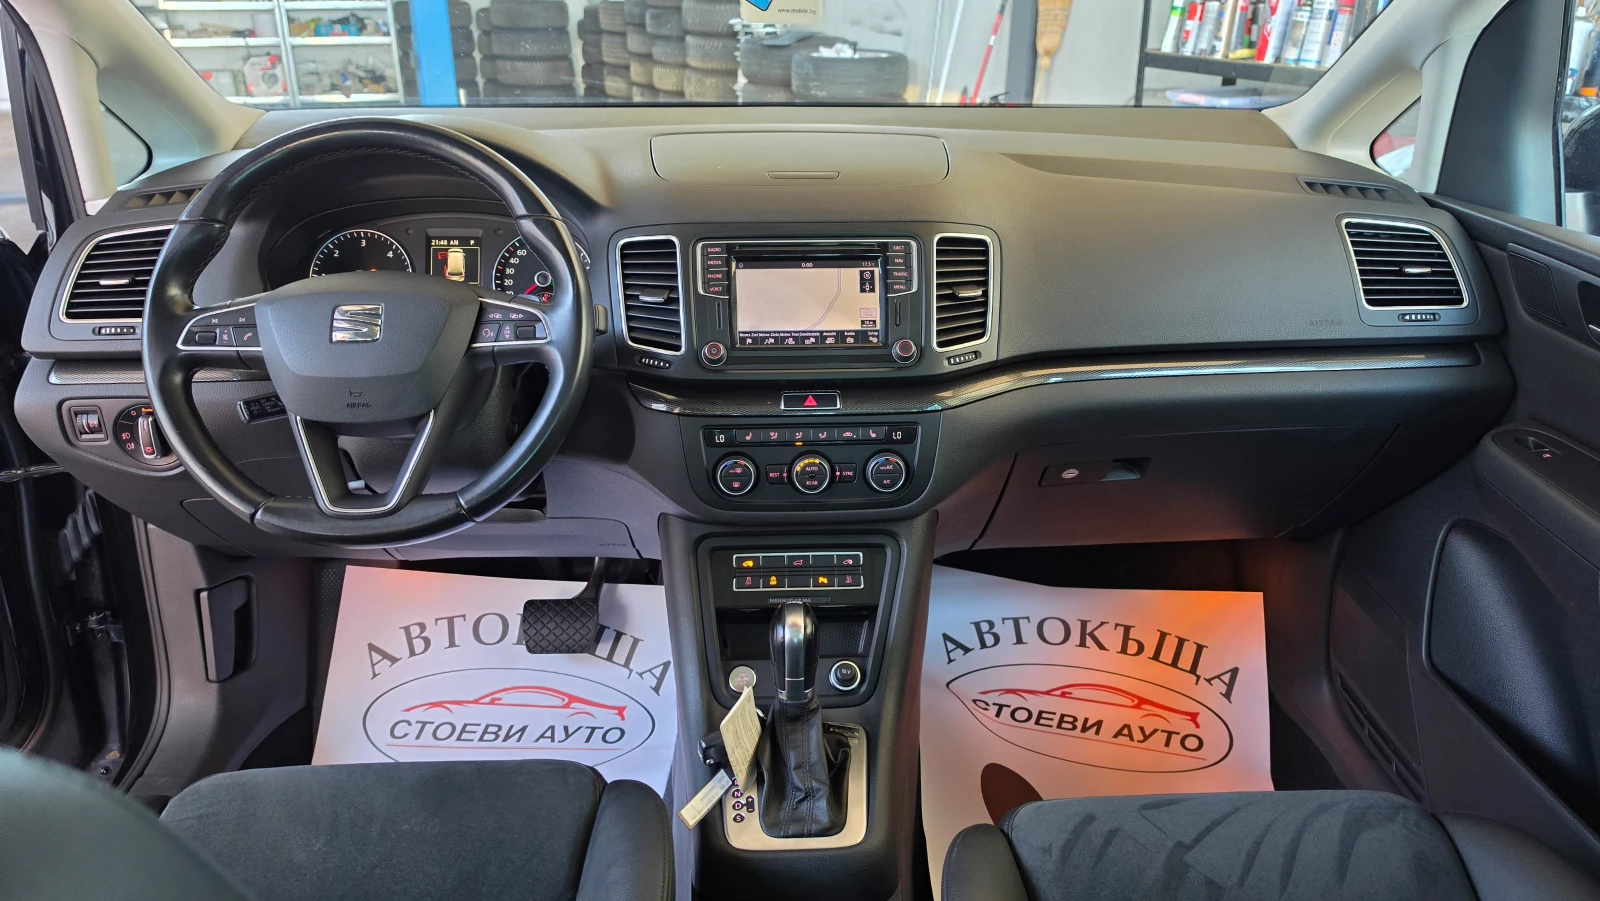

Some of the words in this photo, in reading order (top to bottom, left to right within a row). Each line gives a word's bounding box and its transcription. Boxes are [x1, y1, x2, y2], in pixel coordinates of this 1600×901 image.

[777, 8, 817, 16] www.mobile.bg
[360, 239, 366, 247] 3
[333, 249, 340, 257] 2
[505, 267, 515, 275] 30
[503, 278, 514, 286] 20
[715, 434, 725, 443] LO
[892, 431, 902, 440] LO
[365, 611, 672, 696] АВТОЩА
[941, 615, 1241, 703] АВТОКЪЩА
[971, 698, 1104, 737] СТОЕВИ
[1112, 722, 1205, 753] АУТО
[389, 719, 529, 744] СТОЕВИ
[533, 724, 627, 745] АУТО
